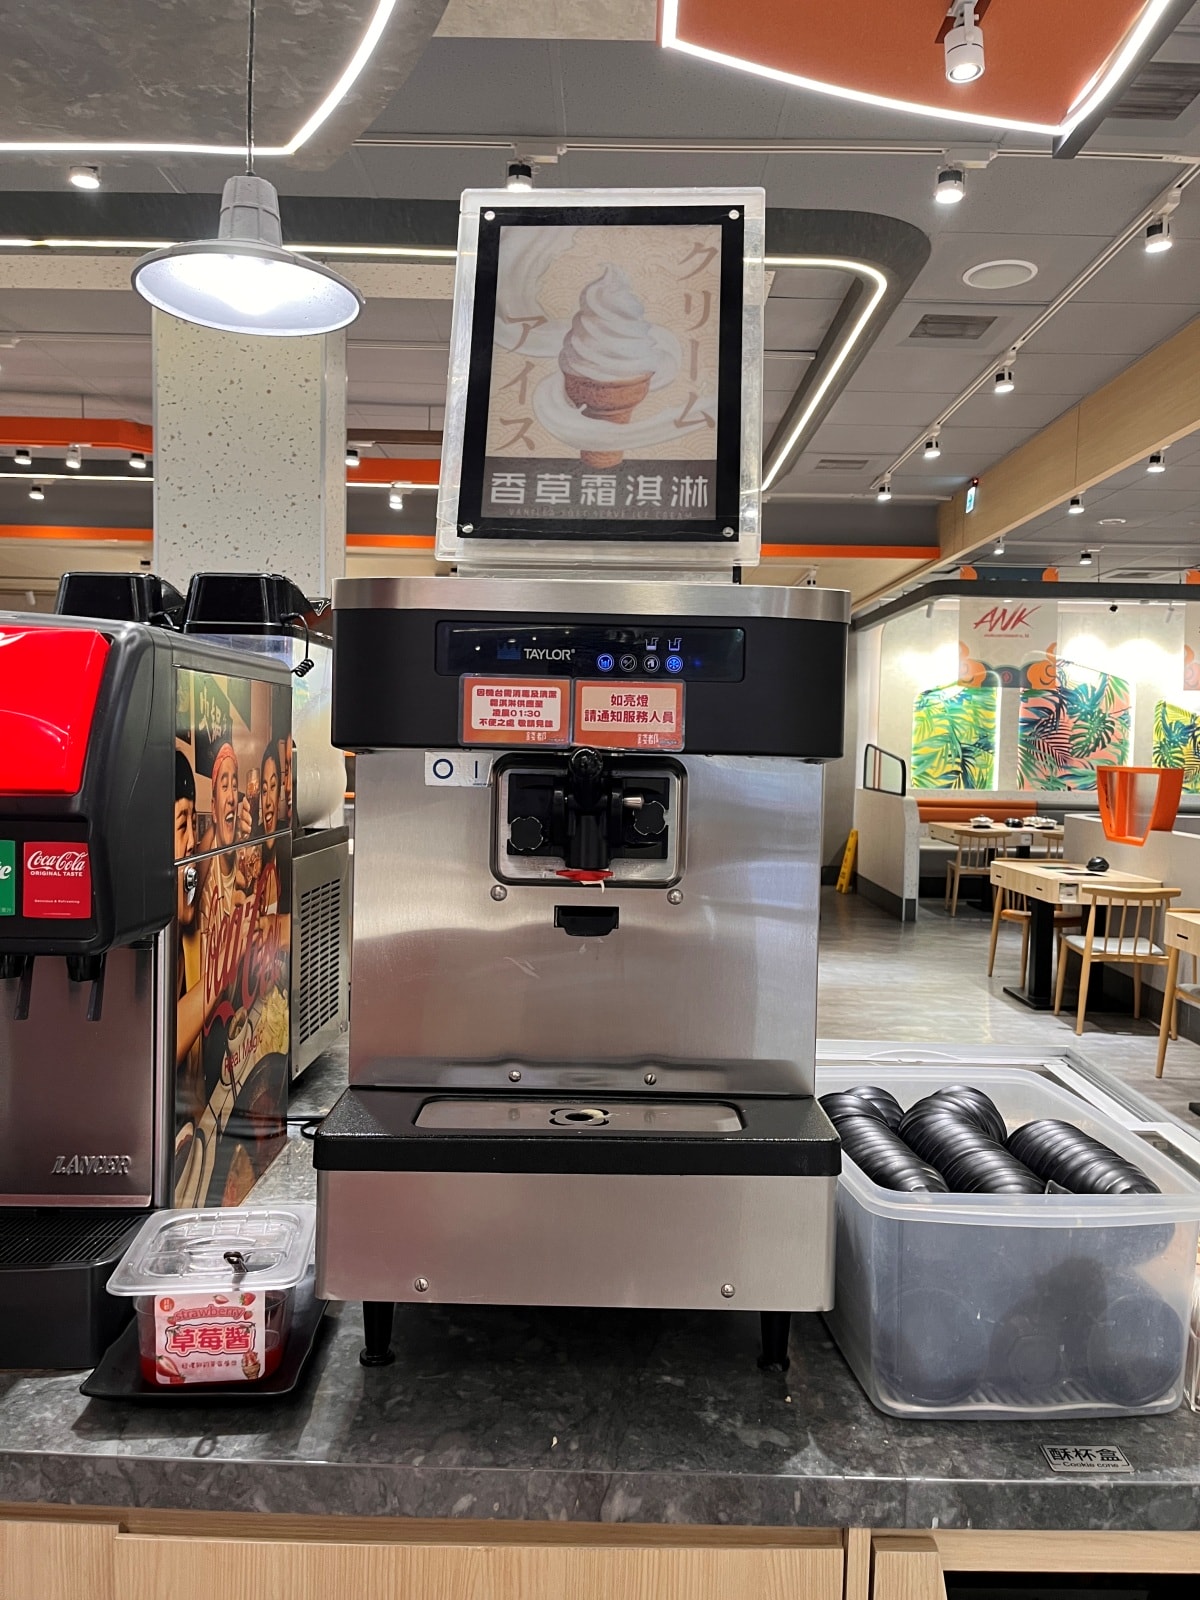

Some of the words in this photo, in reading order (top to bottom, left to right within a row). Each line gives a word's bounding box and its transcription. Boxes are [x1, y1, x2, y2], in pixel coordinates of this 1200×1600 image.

[673, 241, 719, 429] クリーム
[498, 315, 548, 452] アイス
[490, 472, 709, 507] 香草霜淇淋
[973, 602, 1042, 632] ANK
[611, 694, 649, 707] 如亮燈
[584, 710, 674, 724] 請通知服務人員
[51, 1154, 132, 1175] LANCER
[174, 1304, 244, 1320] strawberry
[171, 1325, 250, 1352] 草莓醬
[1047, 1447, 1122, 1461] 酥杯盒
